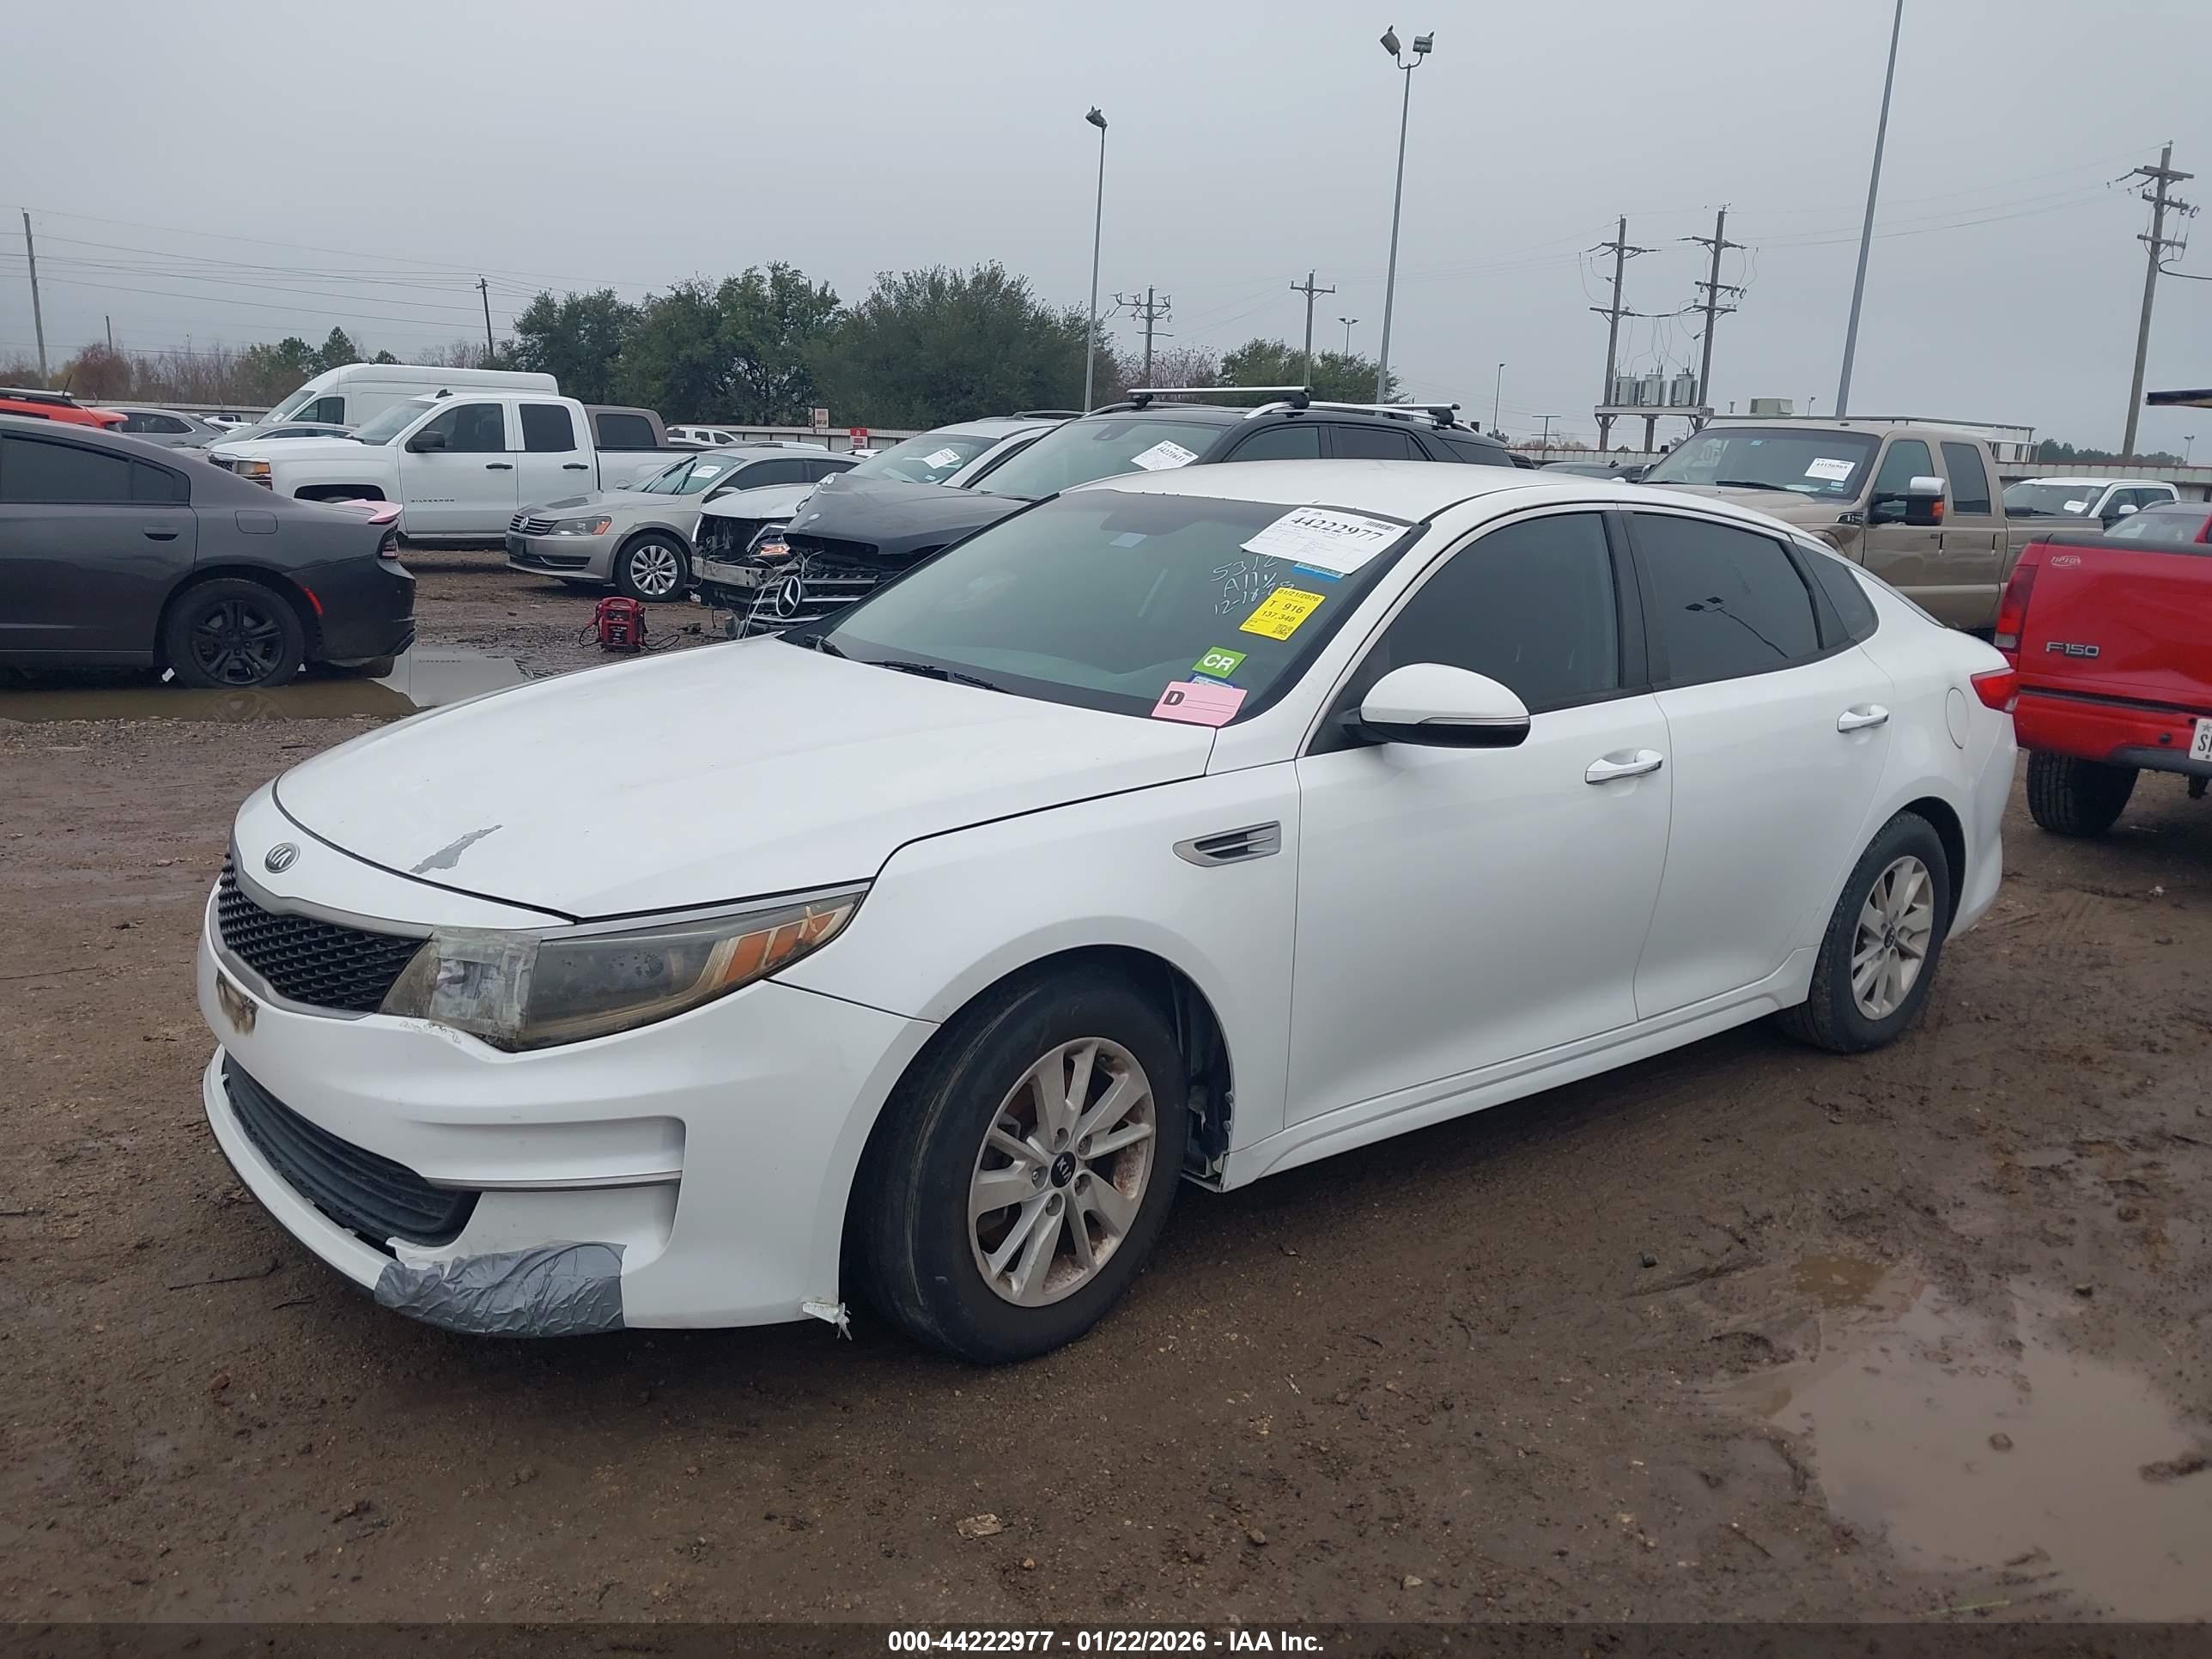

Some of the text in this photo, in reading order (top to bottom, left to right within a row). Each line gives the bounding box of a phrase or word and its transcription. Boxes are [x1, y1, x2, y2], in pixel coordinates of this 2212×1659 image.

[1290, 516, 1384, 542] 44222977
[1277, 588, 1321, 602] 01/21/2026
[1268, 599, 1306, 615] T 916
[1203, 653, 1236, 672] CR
[1163, 690, 1186, 707] D
[2197, 733, 2212, 753] S
[1056, 1156, 1073, 1183] KIA
